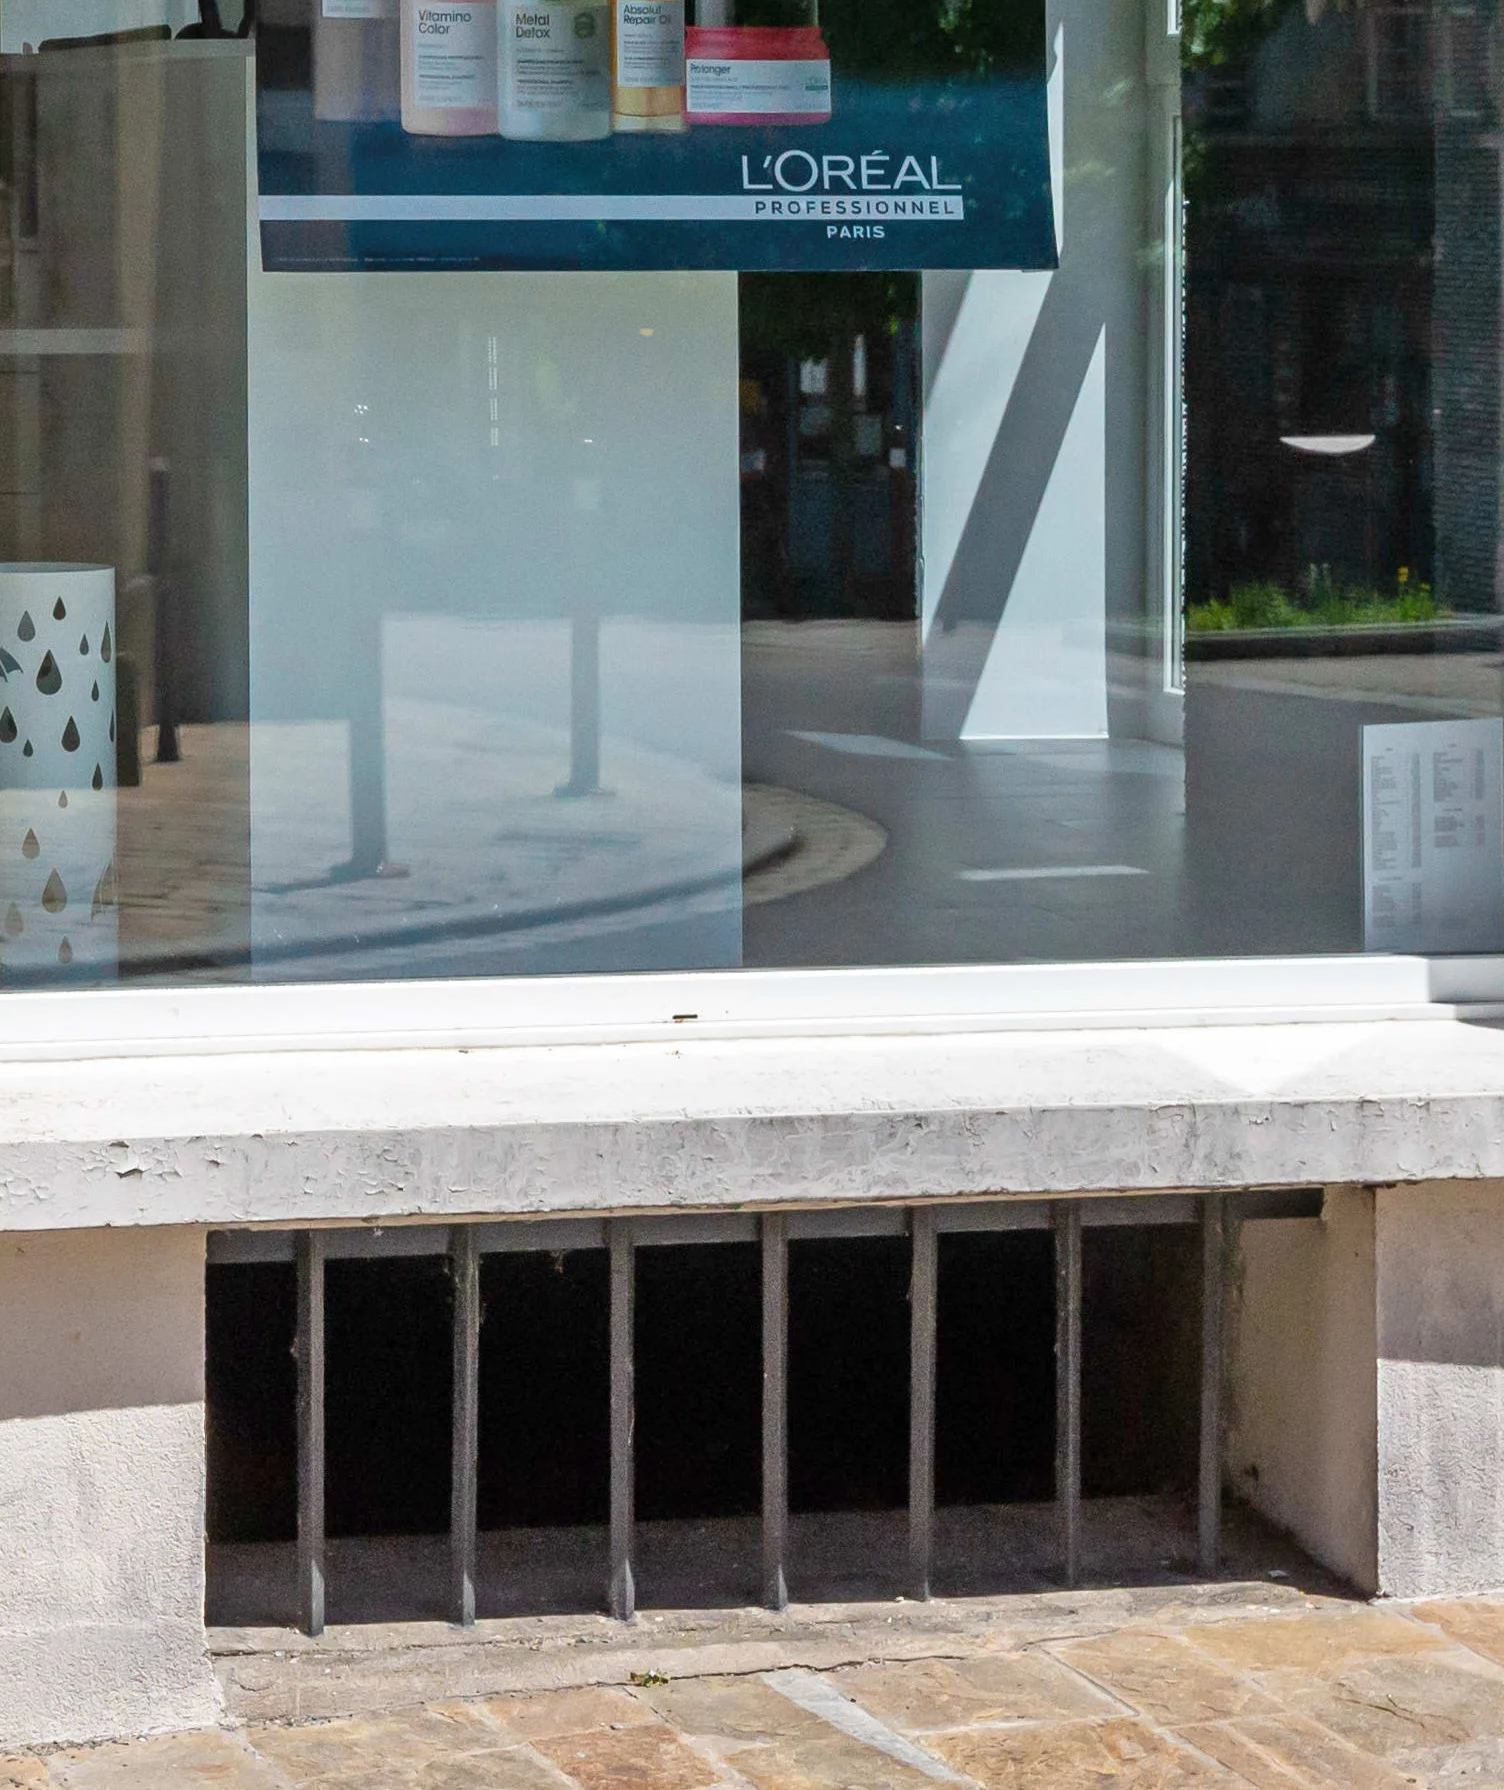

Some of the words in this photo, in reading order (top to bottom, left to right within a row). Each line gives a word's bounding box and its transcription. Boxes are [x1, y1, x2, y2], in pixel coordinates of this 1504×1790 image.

[623, 4, 661, 14] Absolut
[418, 10, 472, 22] Vitamino
[515, 13, 550, 26] Metal
[623, 14, 656, 26] Repair
[418, 22, 450, 34] Color
[515, 26, 551, 39] Detox
[742, 149, 962, 192] L'ORÉAL
[755, 200, 954, 215] PROFESSIONNEL
[826, 225, 886, 239] PARIS
